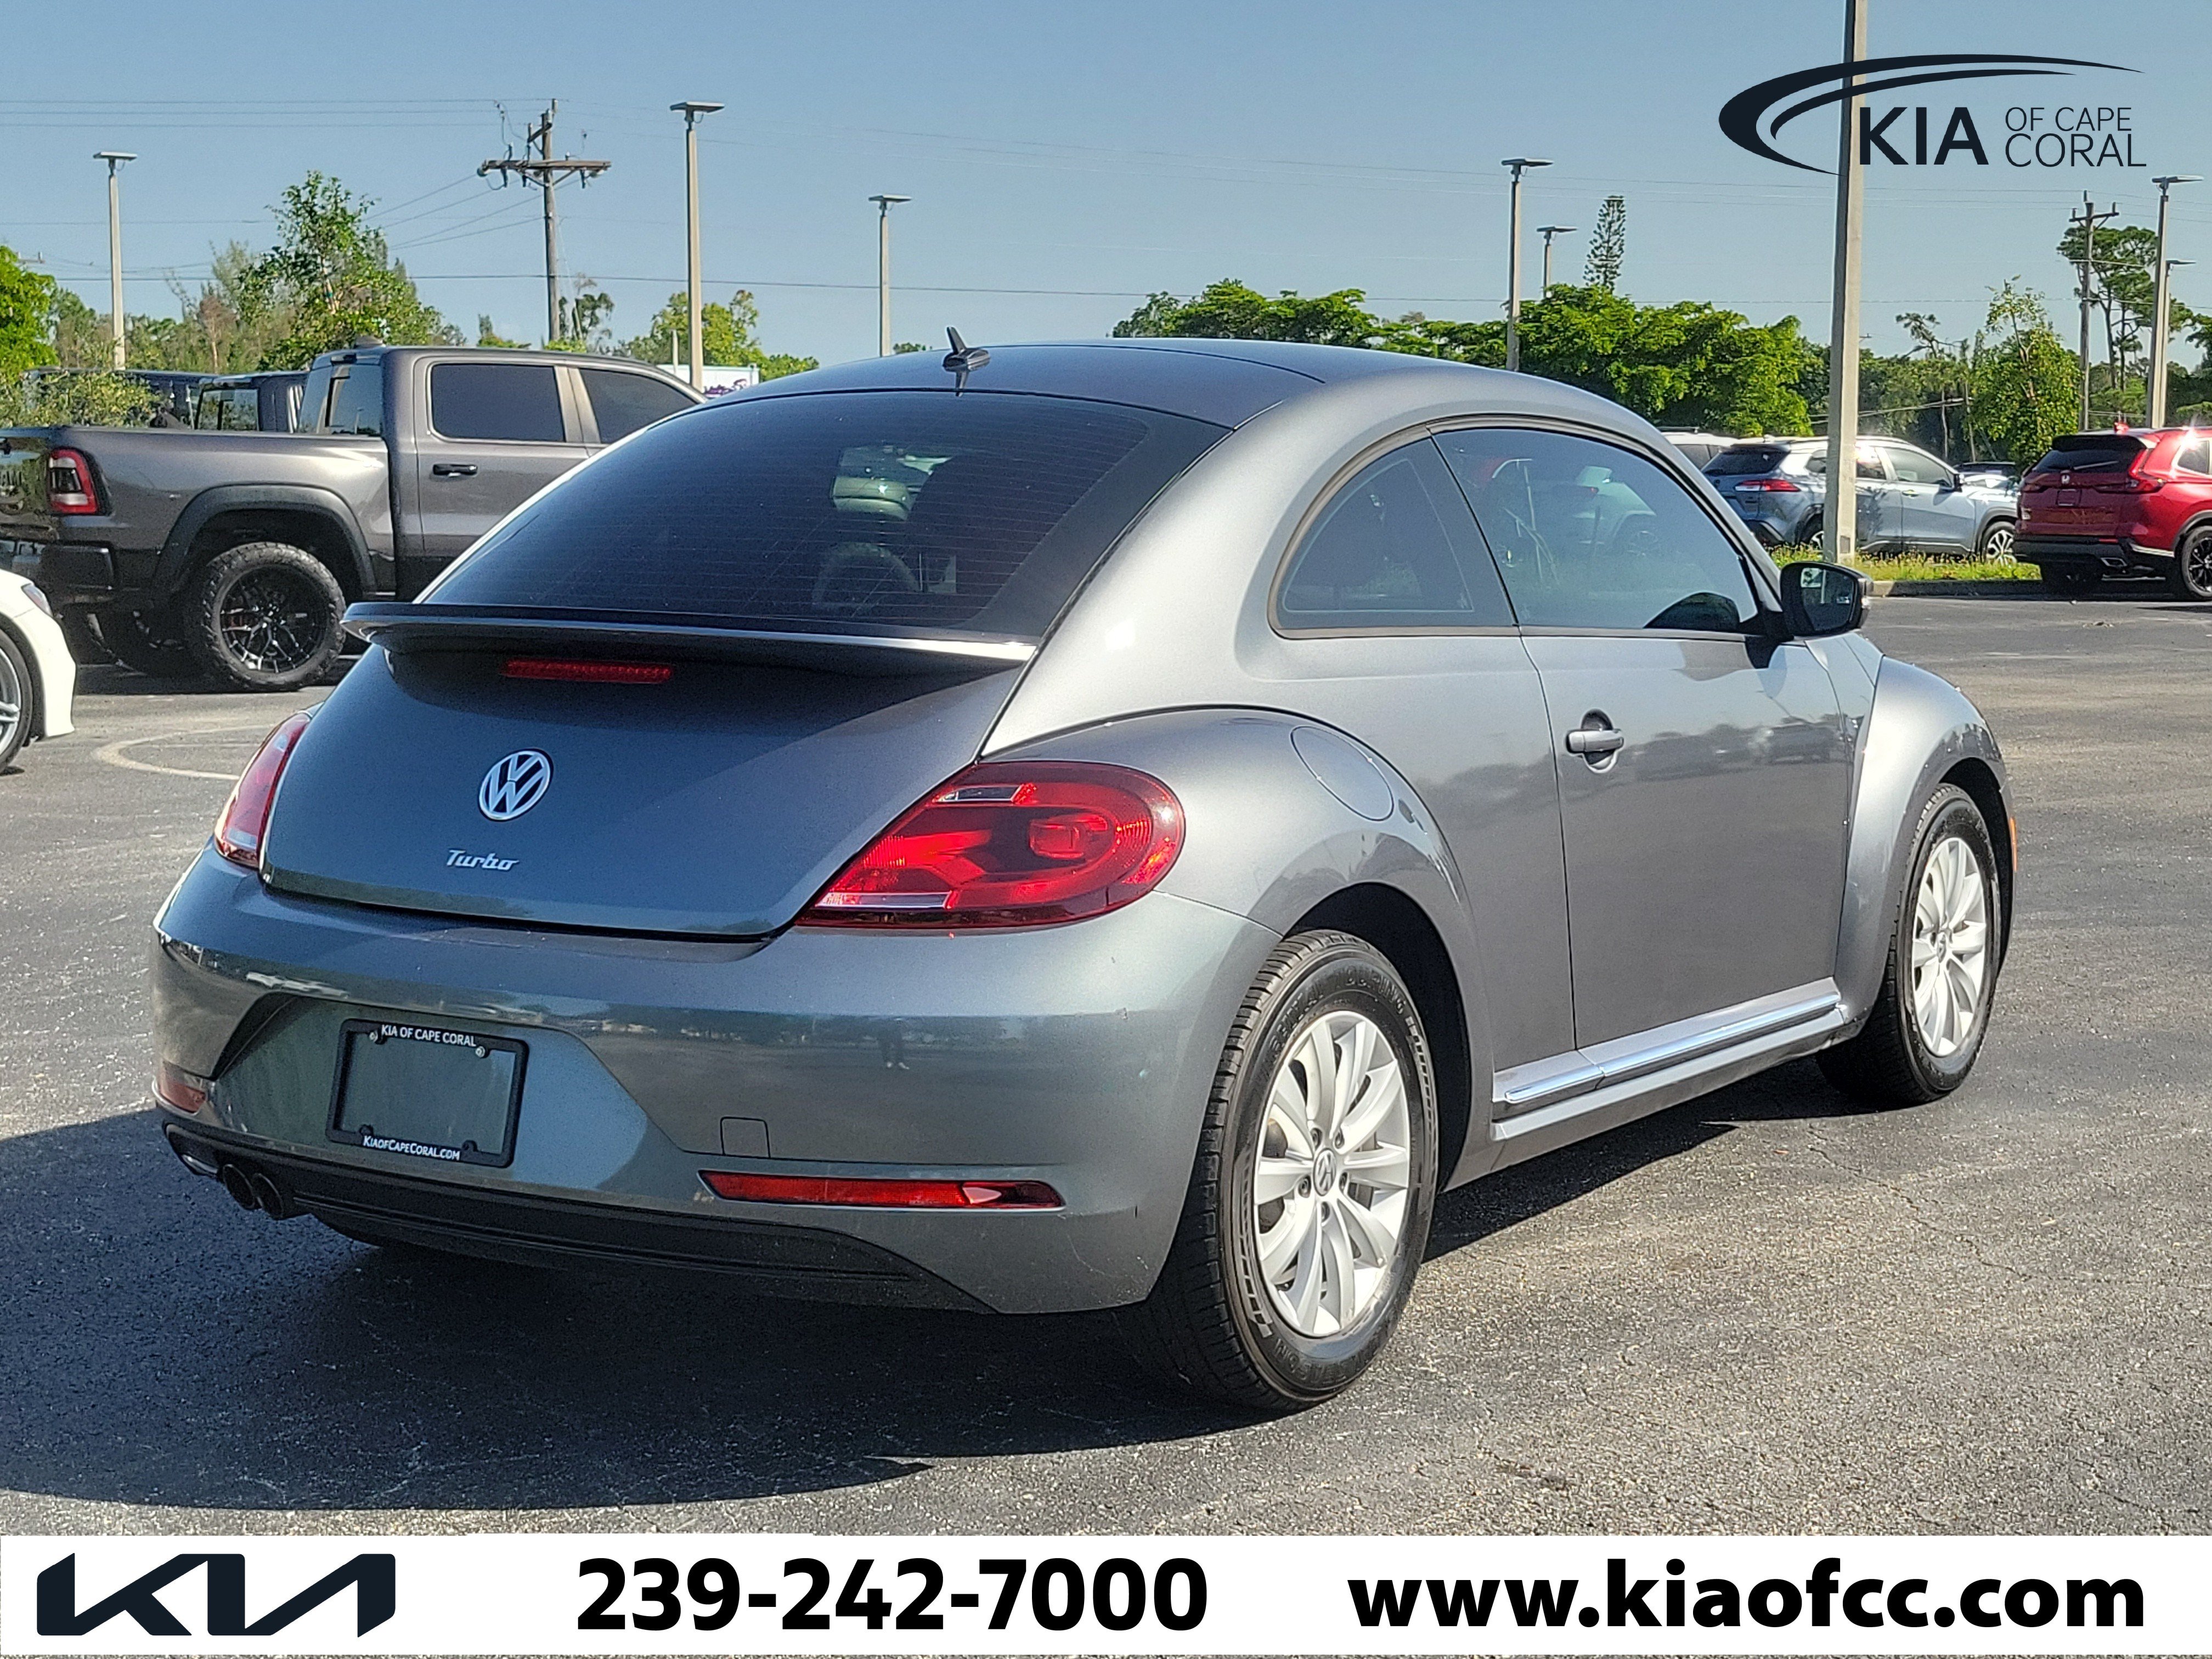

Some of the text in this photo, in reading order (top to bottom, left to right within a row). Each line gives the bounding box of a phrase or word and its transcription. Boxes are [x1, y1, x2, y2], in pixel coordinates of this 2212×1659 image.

[447, 850, 520, 871] Turbo
[381, 1024, 476, 1047] KIA OF CAPE CORAL
